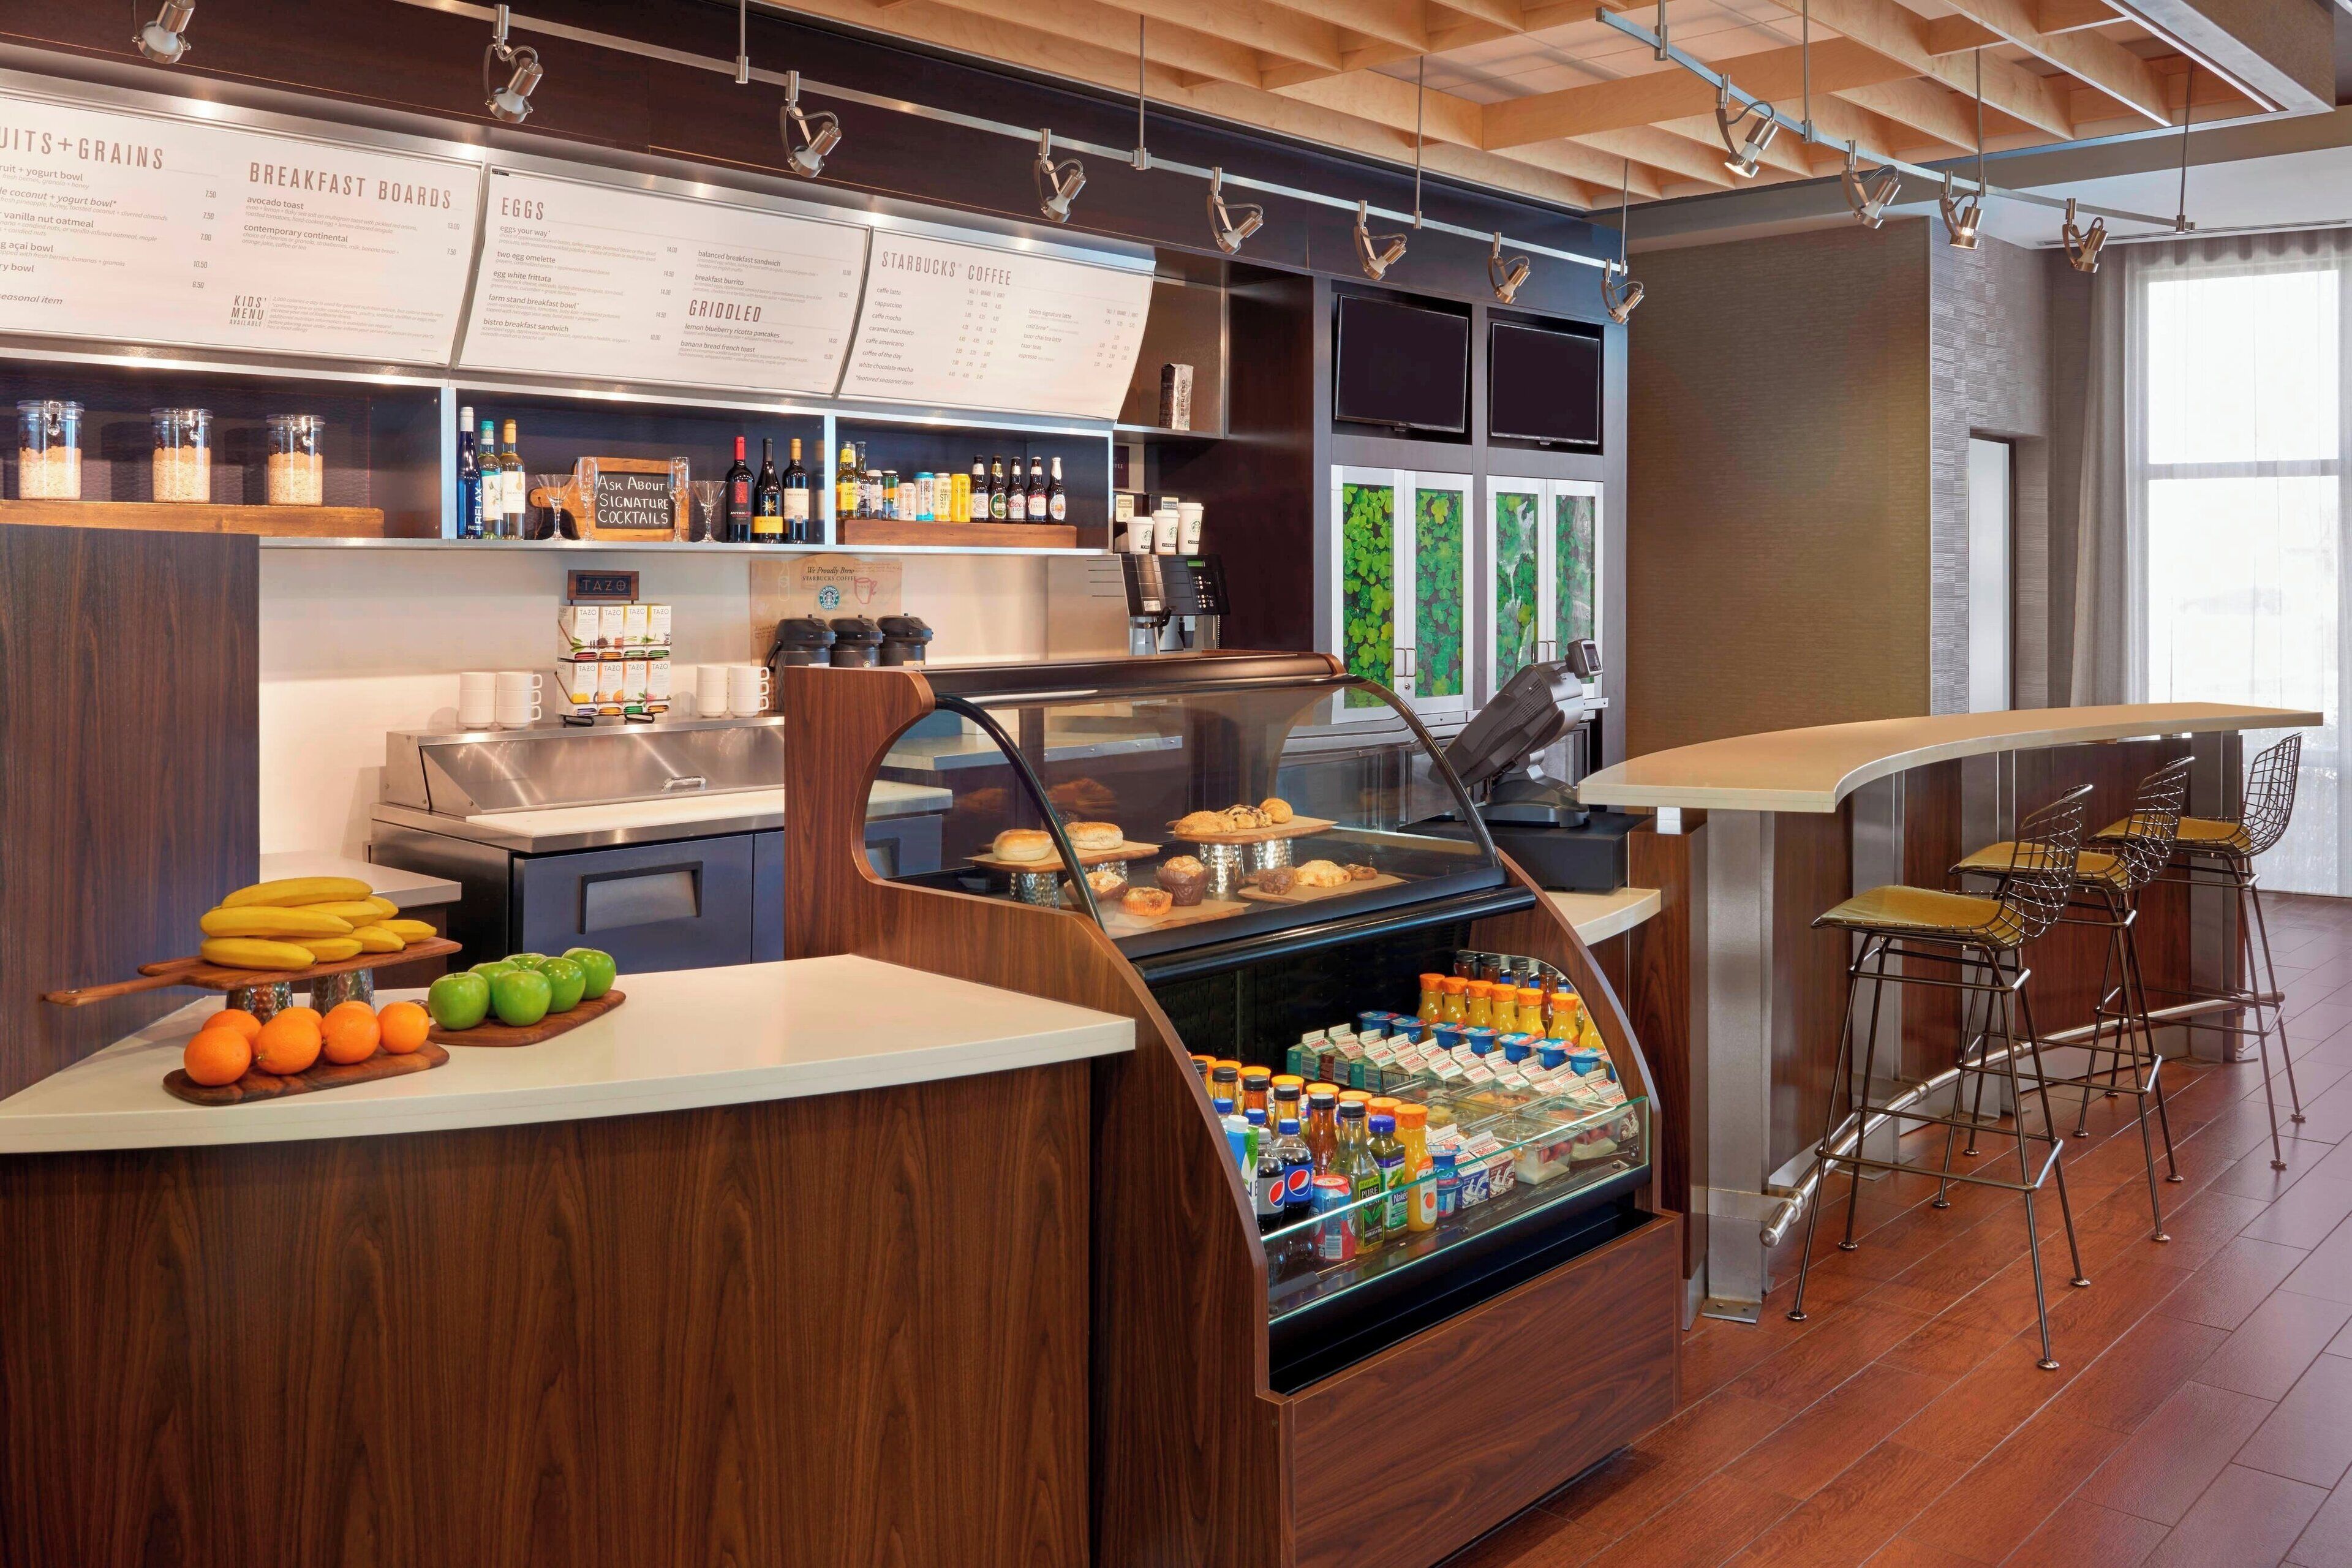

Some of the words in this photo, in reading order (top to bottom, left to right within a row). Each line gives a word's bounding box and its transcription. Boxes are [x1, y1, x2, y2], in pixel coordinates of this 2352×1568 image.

[27, 168, 58, 178] yogurt
[60, 171, 83, 181] bowl
[249, 162, 366, 197] BREAKFAST
[379, 180, 451, 209] BOARDS
[10, 188, 47, 200] coconut
[57, 195, 88, 205] yogurt
[205, 190, 217, 198] 7.50
[247, 197, 281, 206] avocado
[284, 200, 304, 209] toast
[502, 197, 544, 220] EGGS
[4, 212, 35, 222] vanilla
[56, 216, 94, 228] oatmeal
[203, 211, 214, 221] 7.50
[244, 224, 303, 238] contemporary
[303, 232, 348, 243] continental
[500, 225, 516, 234] eggs
[31, 243, 54, 252] bowl
[512, 253, 524, 262] egg
[526, 254, 556, 263] omelette
[698, 250, 725, 260] balanced
[726, 254, 753, 264] breakfast
[11, 263, 34, 273] bowl
[881, 251, 956, 277] STARBUCKS
[968, 265, 1011, 285] COFFEE
[507, 271, 527, 280] white
[527, 273, 552, 282] frittata
[695, 274, 723, 283] breakfast
[42, 295, 63, 305] item
[489, 293, 505, 302] farm
[527, 298, 559, 307] breakfast
[874, 300, 902, 309] cappuccino
[231, 307, 265, 320] MENU
[689, 299, 761, 322] GRIDDLED
[504, 320, 537, 330] breakfast
[538, 323, 569, 333] sandwich
[704, 325, 734, 335] blueberry
[873, 363, 896, 371] chocolate
[600, 493, 669, 510] SIGNATURE
[598, 509, 669, 524] COCKTAILS
[817, 567, 839, 576] Proudly
[582, 580, 626, 592] TAZO
[820, 586, 839, 598] STARBUCKS
[1361, 1186, 1379, 1199] PURE
